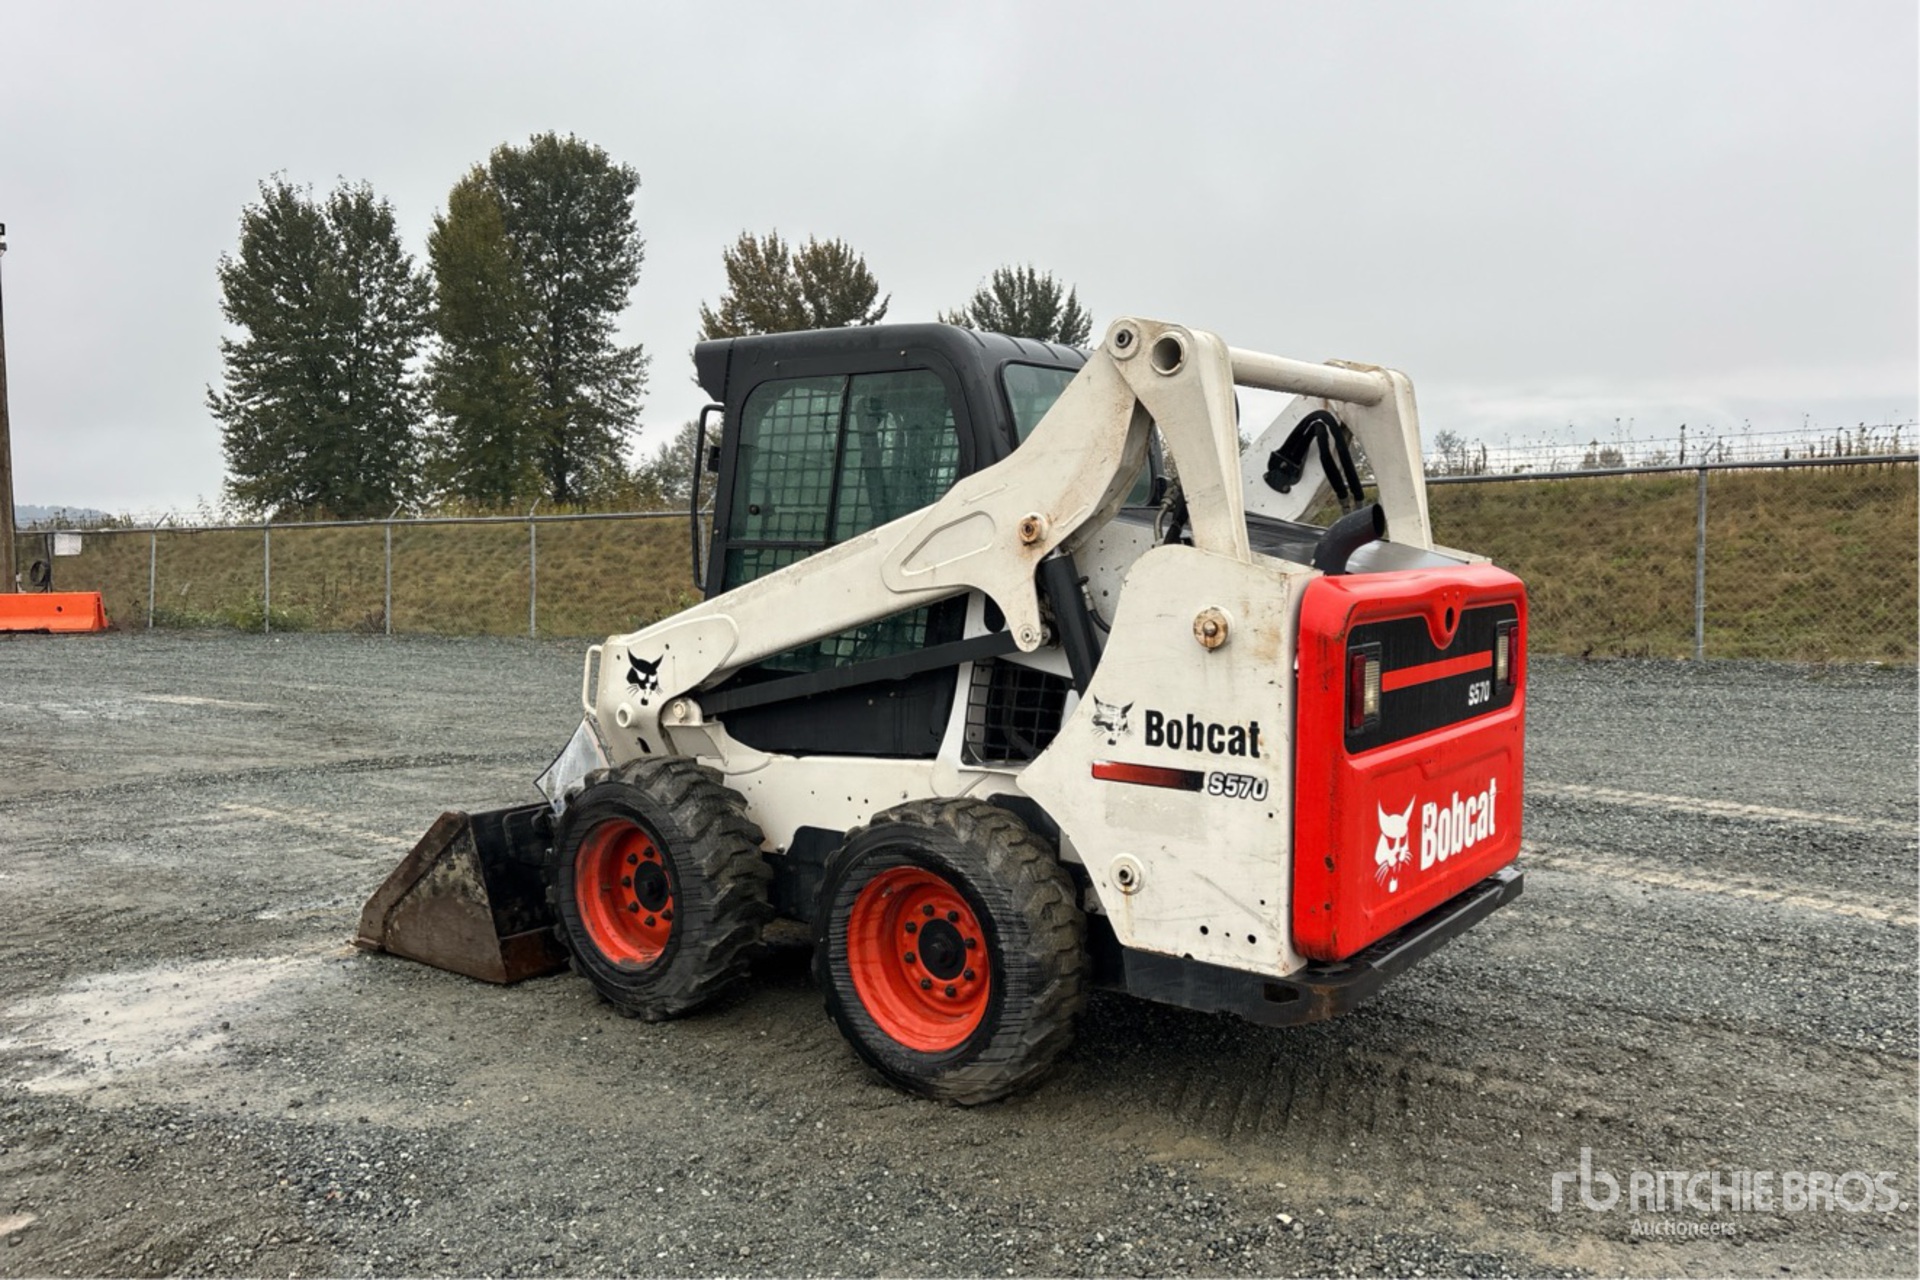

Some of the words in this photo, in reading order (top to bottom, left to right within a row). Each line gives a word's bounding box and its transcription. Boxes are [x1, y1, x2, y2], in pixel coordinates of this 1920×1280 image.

[1467, 681, 1490, 706] S570
[1145, 709, 1260, 758] Bobcat
[1207, 772, 1268, 801] S570
[1420, 777, 1496, 871] Bobcat
